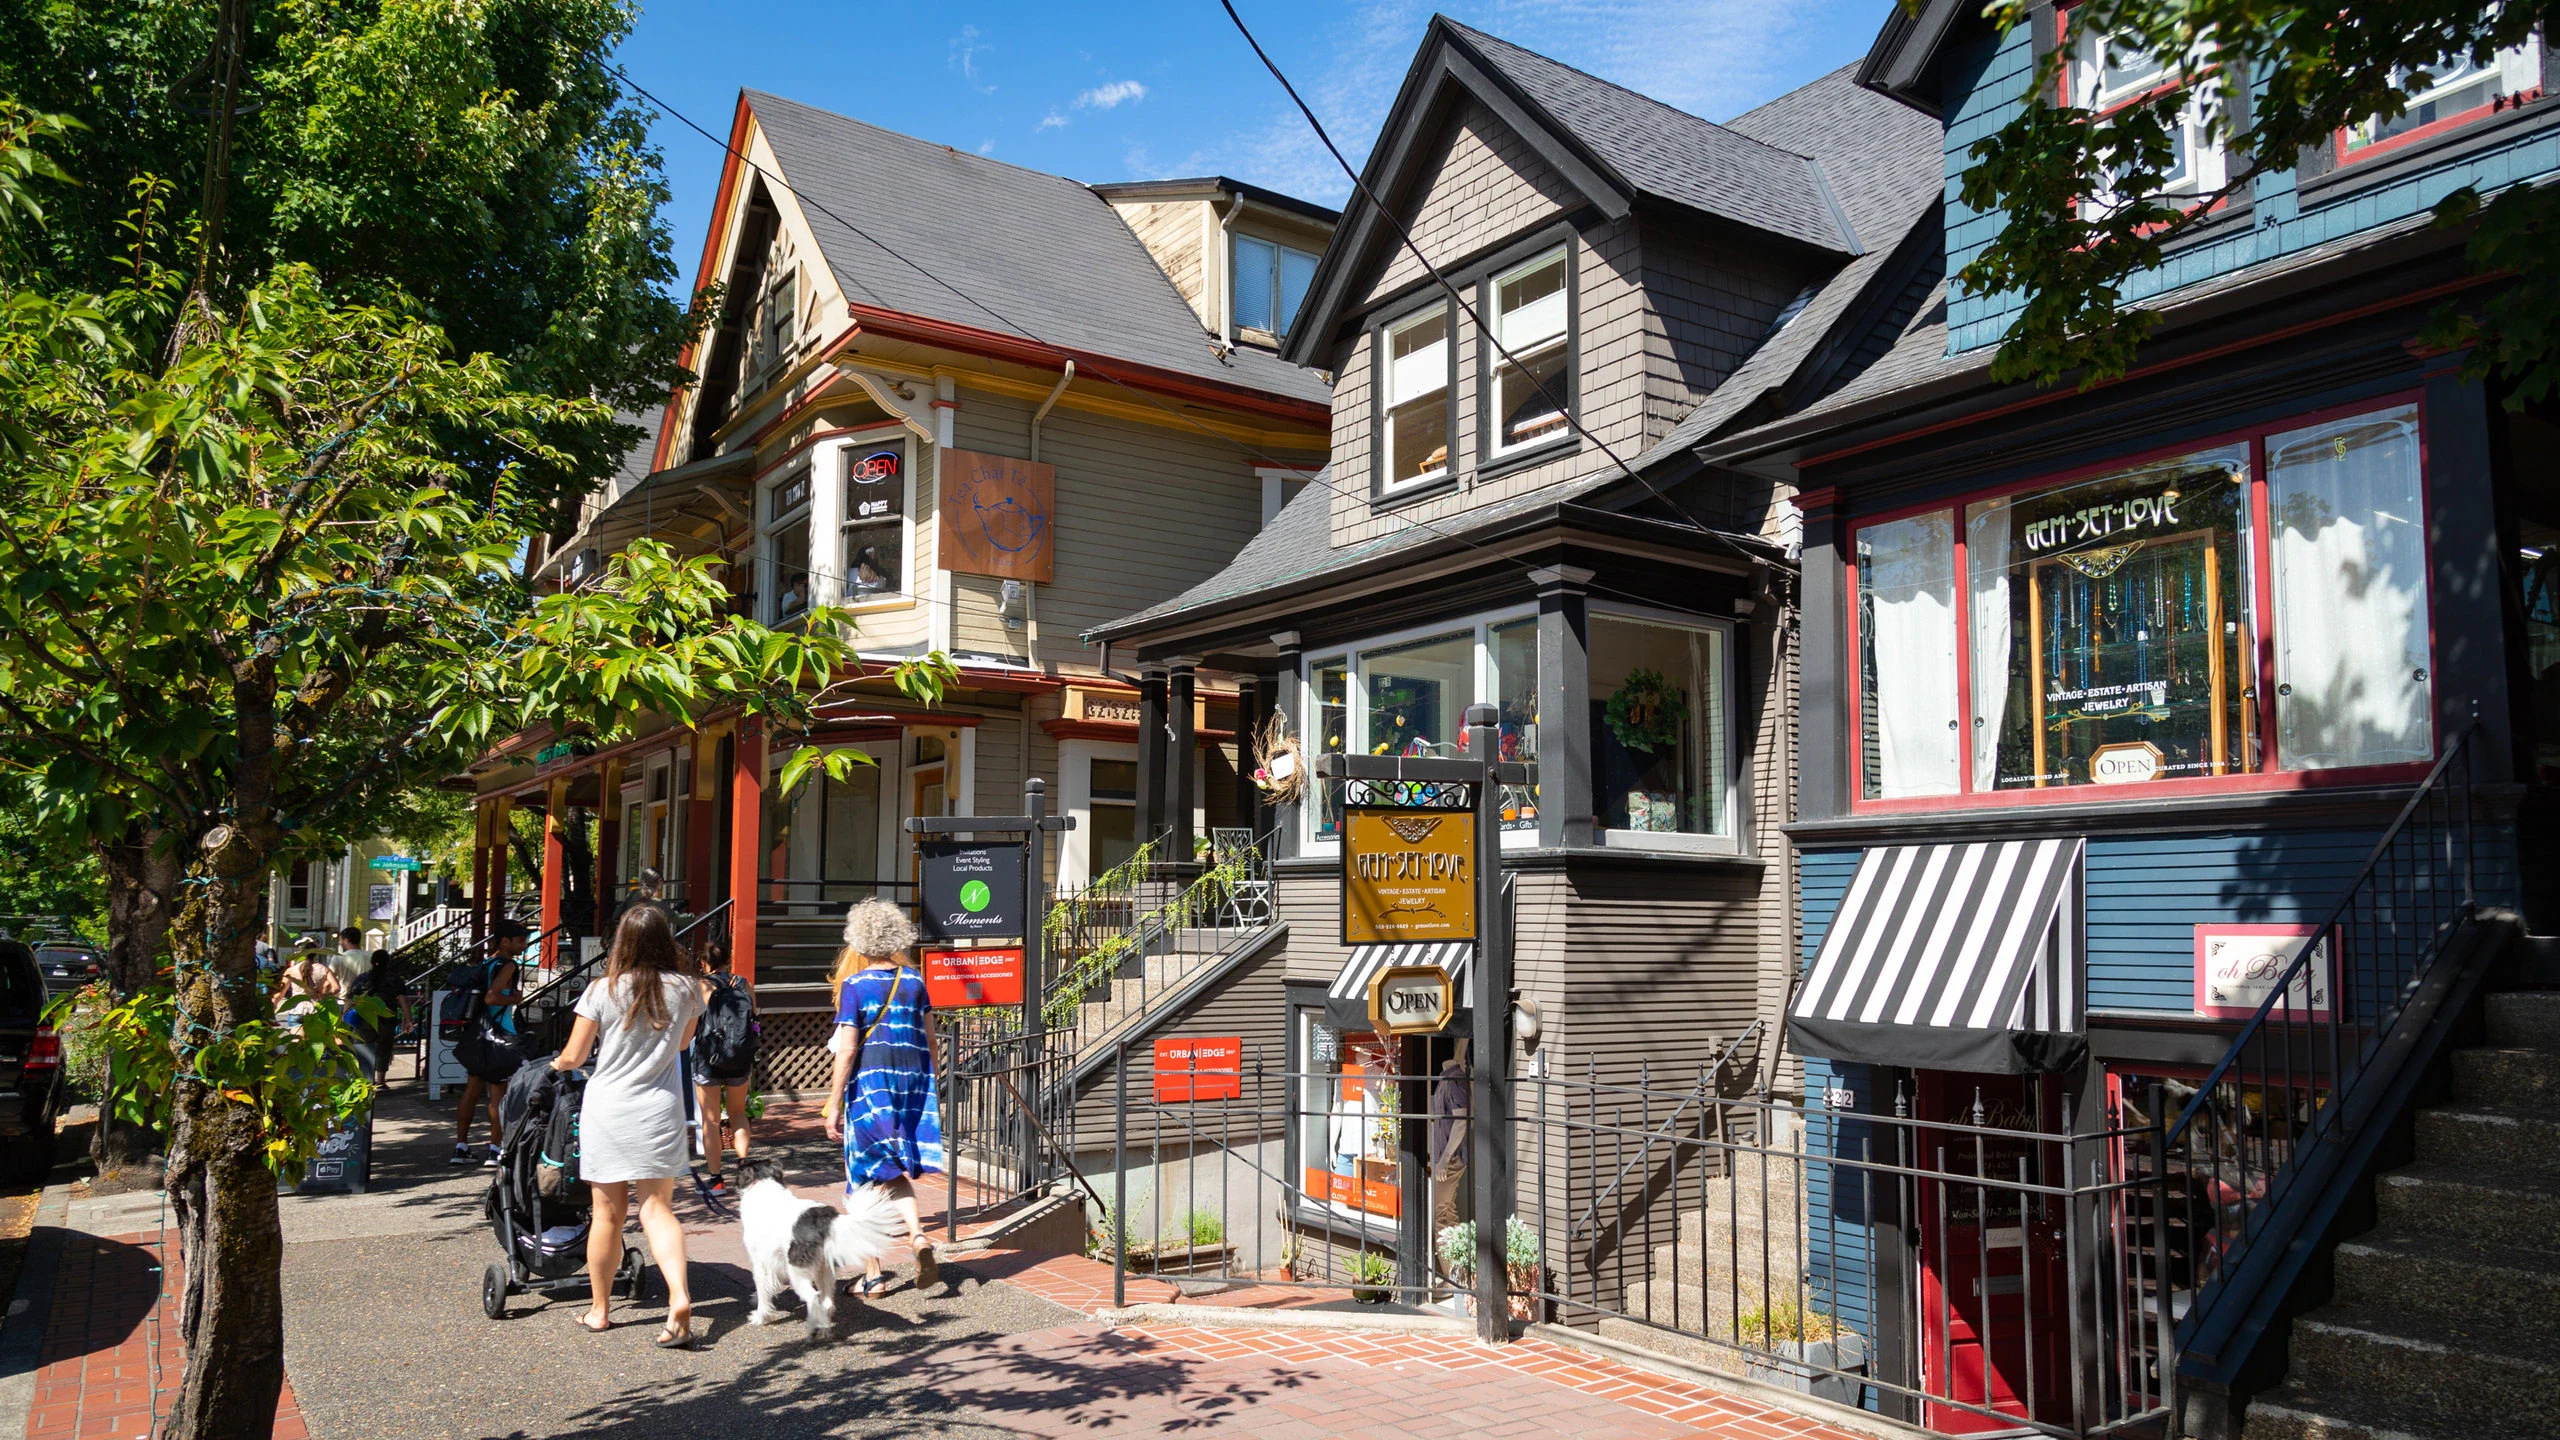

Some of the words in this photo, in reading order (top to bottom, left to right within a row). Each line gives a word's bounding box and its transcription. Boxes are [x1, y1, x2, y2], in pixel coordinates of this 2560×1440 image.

[853, 458, 898, 479] OPEN
[948, 482, 973, 505] Tea
[971, 464, 1003, 484] Chai
[2025, 515, 2067, 551] GEM
[2076, 504, 2113, 540] SET
[2123, 495, 2179, 531] LOVE
[2046, 690, 2084, 702] VINTAGE
[2087, 685, 2122, 698] ESTATE
[2126, 680, 2167, 693] ARTISAN
[2081, 698, 2129, 712] JEWELRY
[2100, 759, 2151, 776] OPEN
[1519, 820, 1533, 829] Gifts
[955, 856, 972, 864] Event
[972, 856, 991, 865] Styling
[1358, 852, 1390, 881] GEM
[1396, 851, 1423, 880] SET
[1429, 851, 1465, 883] LOVE
[943, 912, 1003, 927] Moments
[943, 957, 975, 967] URBAN
[978, 955, 1004, 965] EDGE
[980, 971, 1013, 979] ACCESSORIES
[2217, 960, 2240, 980] oh
[1388, 991, 1439, 1012] OPEN
[1202, 1048, 1225, 1058] EDGE
